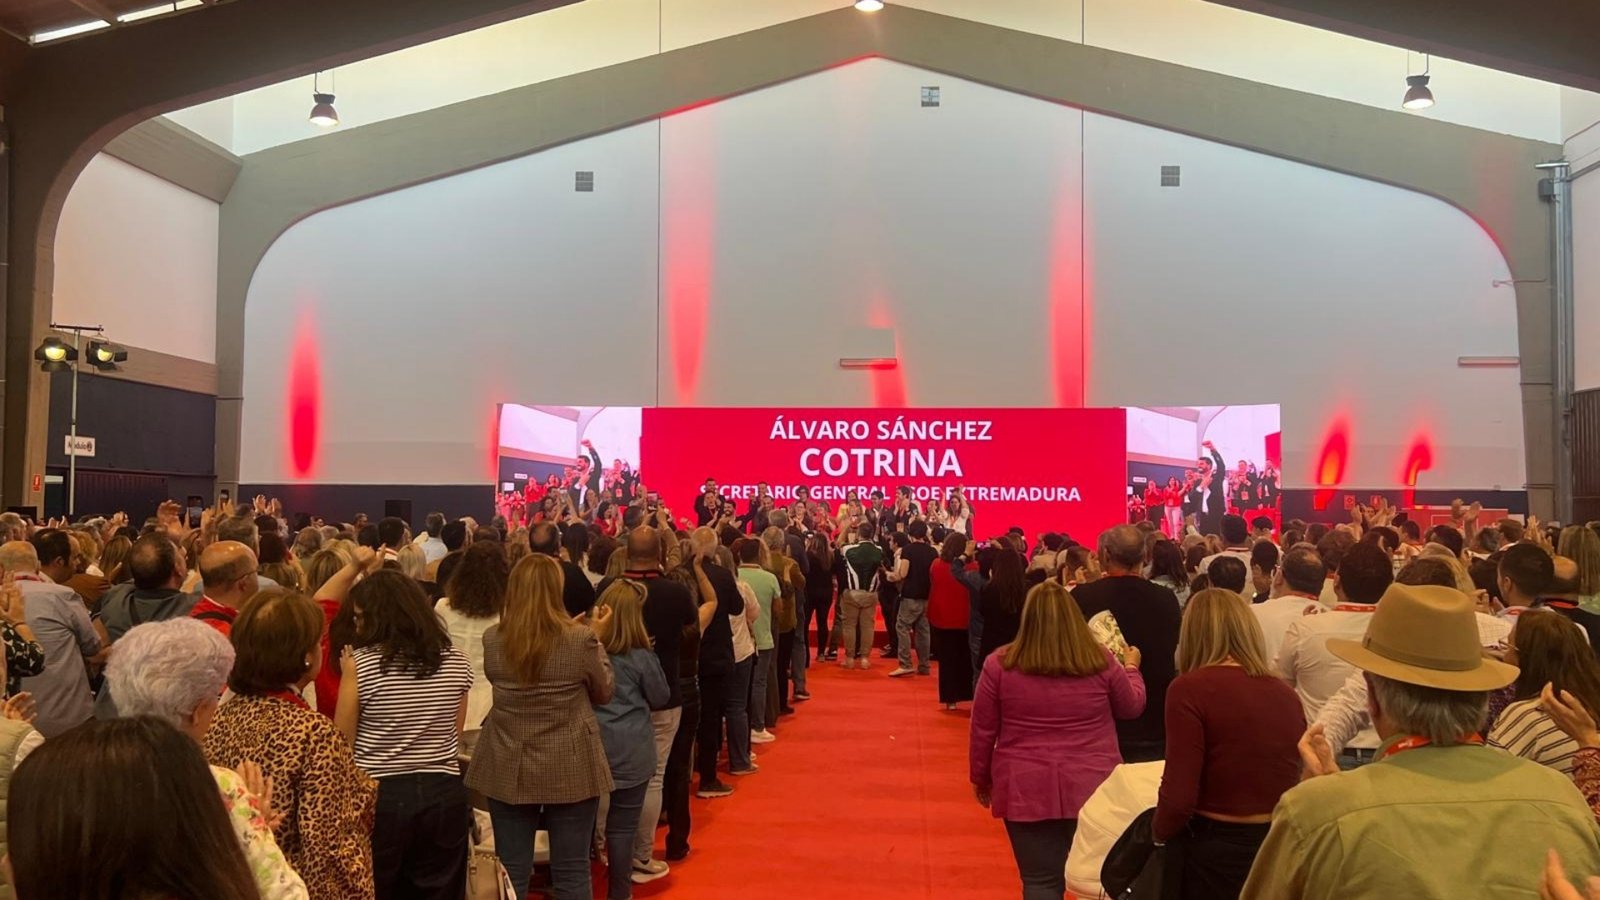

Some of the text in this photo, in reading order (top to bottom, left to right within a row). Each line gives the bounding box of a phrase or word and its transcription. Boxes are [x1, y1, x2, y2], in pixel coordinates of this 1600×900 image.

[769, 415, 993, 441] ÁLVARO SÁNCHEZ
[799, 447, 964, 478] COTRINA
[700, 484, 806, 500] CRETARIO
[896, 485, 941, 501] SOE
